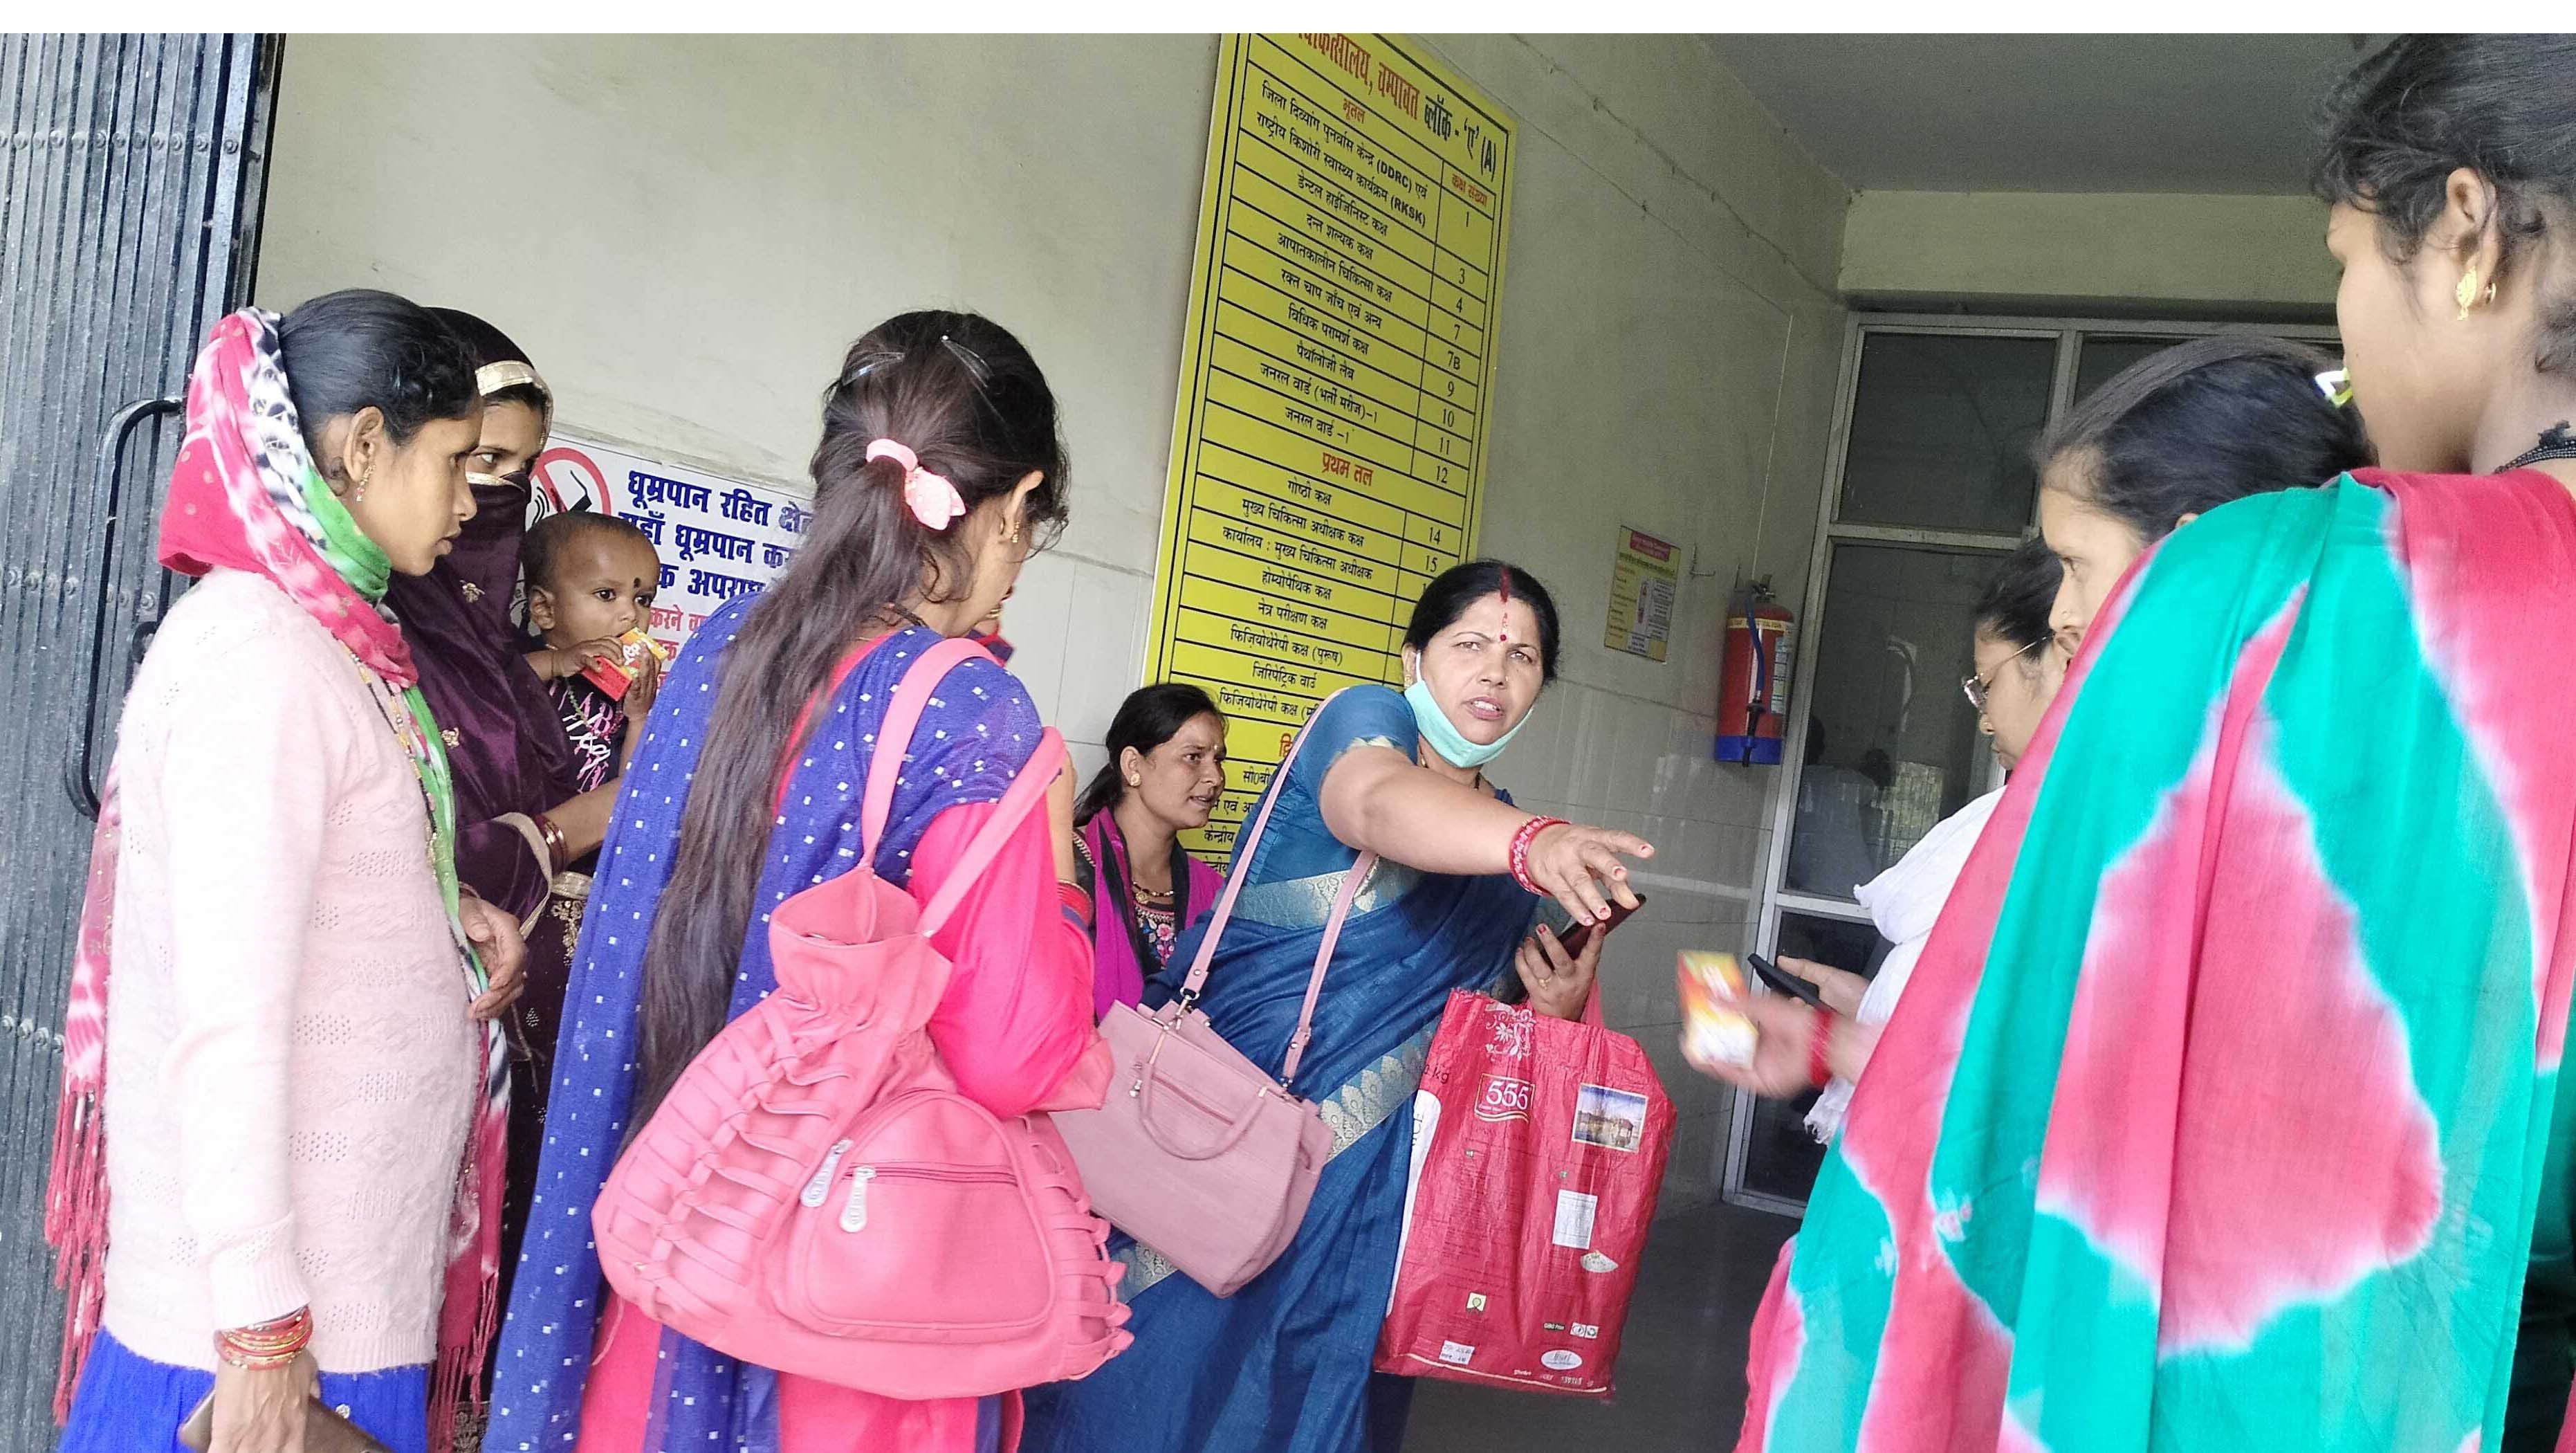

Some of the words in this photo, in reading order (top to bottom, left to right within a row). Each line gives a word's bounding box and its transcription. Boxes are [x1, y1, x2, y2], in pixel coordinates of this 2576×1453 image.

[1262, 80, 1287, 110] जिला
[1377, 159, 1412, 192] (DDRC)
[1415, 181, 1428, 199] एवं
[1257, 111, 1287, 140] राष्ट्रीय
[1356, 171, 1388, 201] कार्यक्रम
[1390, 194, 1426, 228] (RKSK)
[1372, 217, 1388, 237] कक्ष
[1357, 242, 1373, 261] कक्ष
[1278, 232, 1335, 274] आपातकालीन
[1338, 259, 1374, 293] चिकित्सा
[1377, 284, 1393, 303] कक्ष
[1459, 267, 1466, 284] 3
[1281, 268, 1300, 289] रक्त
[1304, 279, 1323, 300] चाप
[1348, 302, 1362, 320] एवं
[1364, 311, 1382, 329] अन्य
[1456, 296, 1463, 313] 4
[1321, 321, 1350, 346] परामर्श
[1352, 336, 1370, 355] कक्ष
[1454, 323, 1460, 340] 7
[1447, 349, 1461, 371] 7B
[1260, 362, 1289, 387] जनरल
[1293, 375, 1312, 396] वार्ड
[1447, 381, 1455, 397] 9
[1285, 406, 1313, 430] जनरल
[1316, 417, 1334, 437] वार्ड
[1442, 408, 1455, 428] 10
[1439, 437, 1451, 455] 11
[1322, 452, 1350, 479] प्रथम
[1354, 464, 1374, 486] तल
[1436, 466, 1448, 484] 12
[1287, 476, 1312, 500] गोष्ठी
[1314, 491, 1332, 506] कक्ष
[719, 488, 772, 527] रहित
[1242, 498, 1264, 518] मुख्य
[1268, 502, 1307, 530] चिकित्सा
[1311, 518, 1345, 541] अधीक्षक
[1348, 533, 1365, 547] कक्ष
[1428, 527, 1441, 545] 14
[1223, 525, 1263, 549] कार्यालय
[1275, 541, 1296, 560] मुख्य
[1300, 545, 1336, 571] चिकित्सा
[1340, 558, 1374, 581] अधीक्षक
[1425, 555, 1438, 573] 15
[1315, 585, 1332, 601] कक्ष
[1258, 597, 1274, 618] नेत्र
[1276, 603, 1308, 625] परीक्षण
[1311, 615, 1329, 630] कक्ष
[1292, 641, 1309, 657] कक्ष
[1281, 702, 1298, 717] कक्ष
[1486, 1080, 1529, 1110] 555
